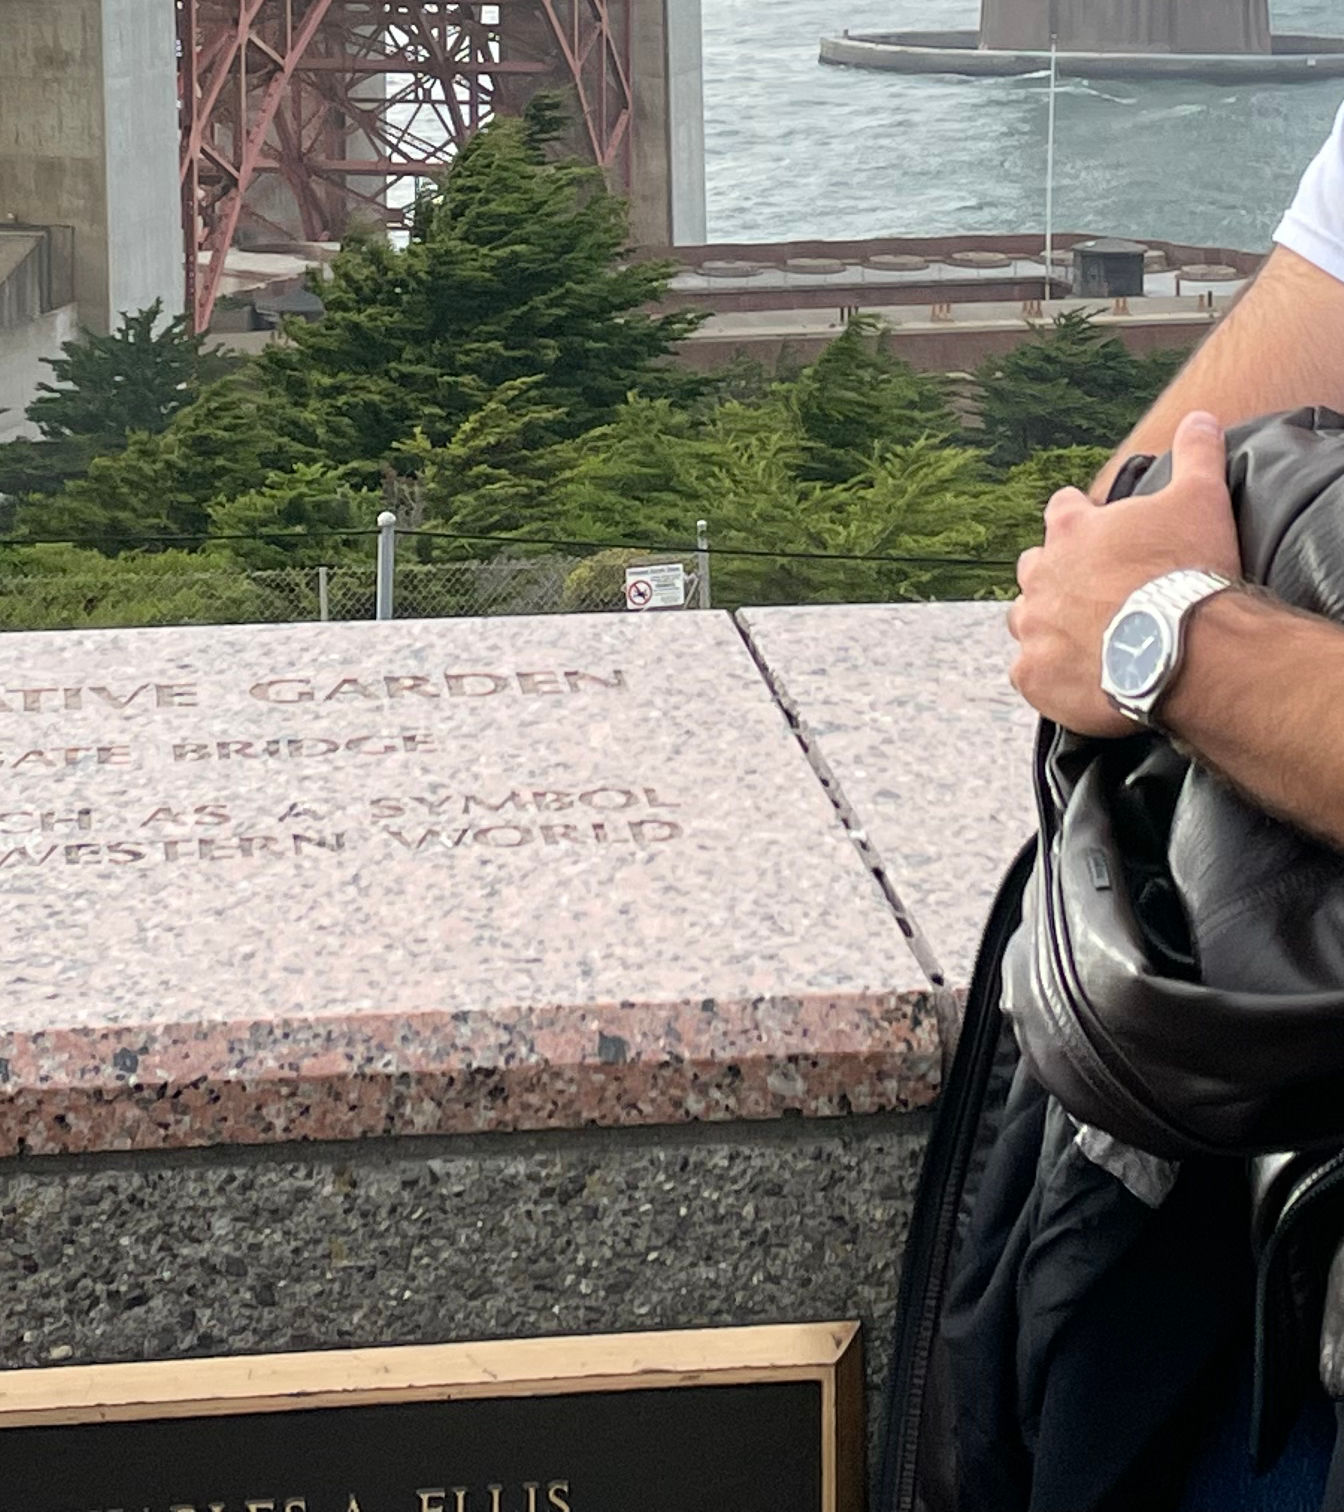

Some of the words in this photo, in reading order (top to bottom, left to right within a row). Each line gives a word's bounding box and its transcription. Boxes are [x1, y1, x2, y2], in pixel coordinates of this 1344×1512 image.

[249, 669, 628, 704] GARDEN
[172, 730, 438, 762] BRIDGE
[140, 804, 232, 828] AS
[278, 801, 326, 823] A
[370, 787, 682, 820] SYMBOL
[384, 818, 685, 850] WORLD
